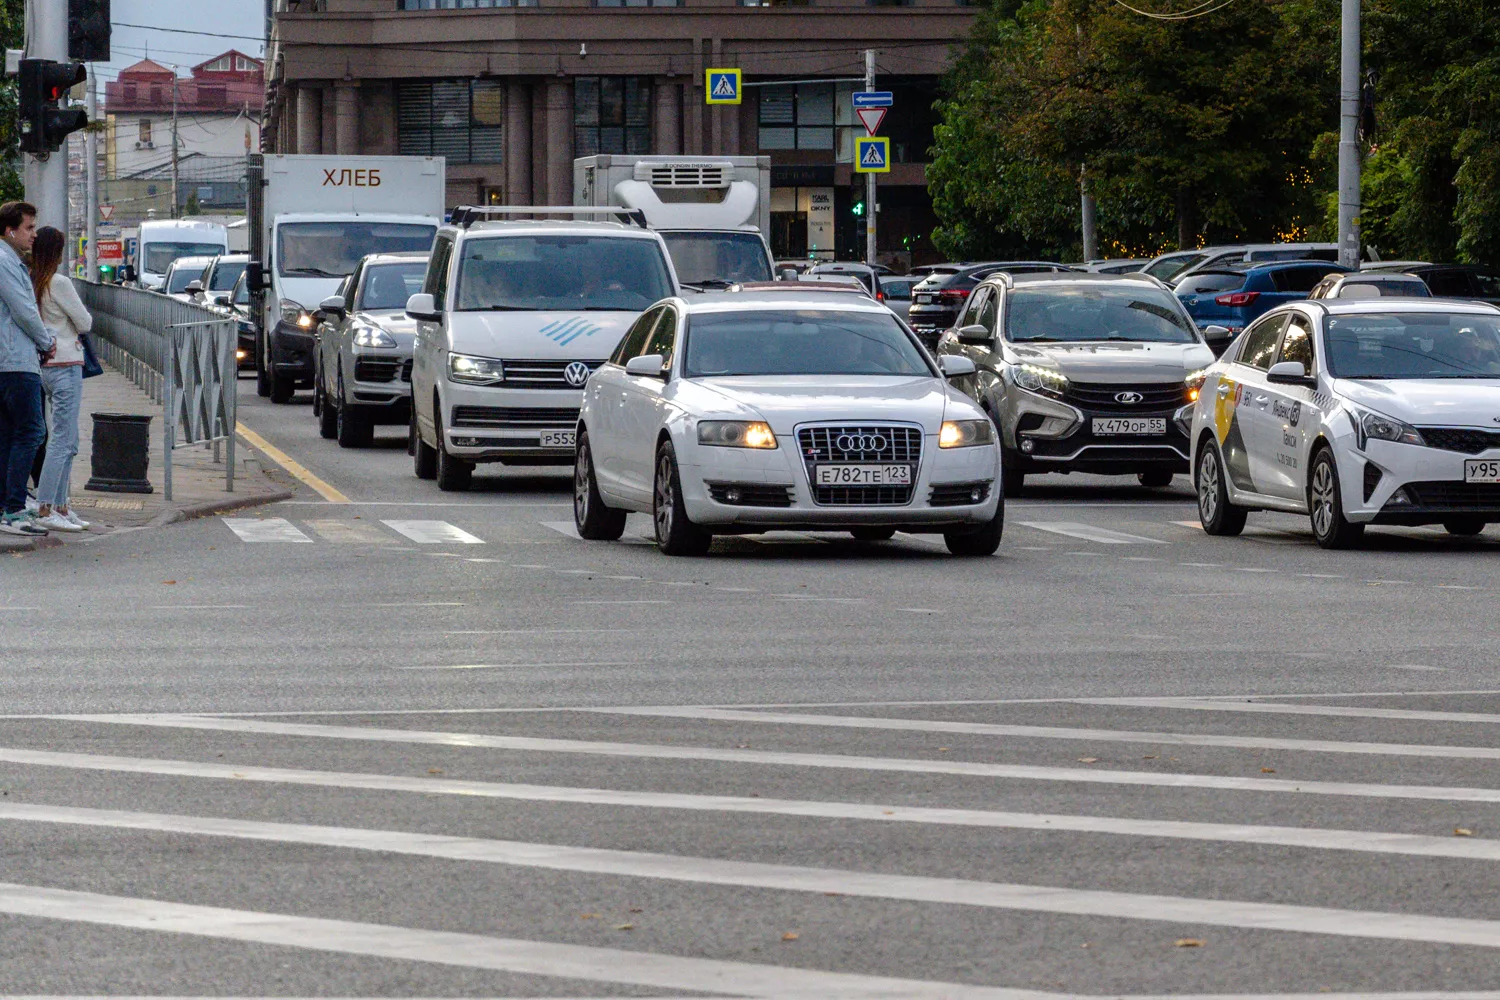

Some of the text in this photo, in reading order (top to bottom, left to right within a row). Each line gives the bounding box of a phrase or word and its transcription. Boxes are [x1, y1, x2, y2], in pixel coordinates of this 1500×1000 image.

[322, 168, 381, 187] ХЛЕБ
[1149, 419, 1162, 428] 55
[822, 466, 907, 483] Е782ТЕ 123
